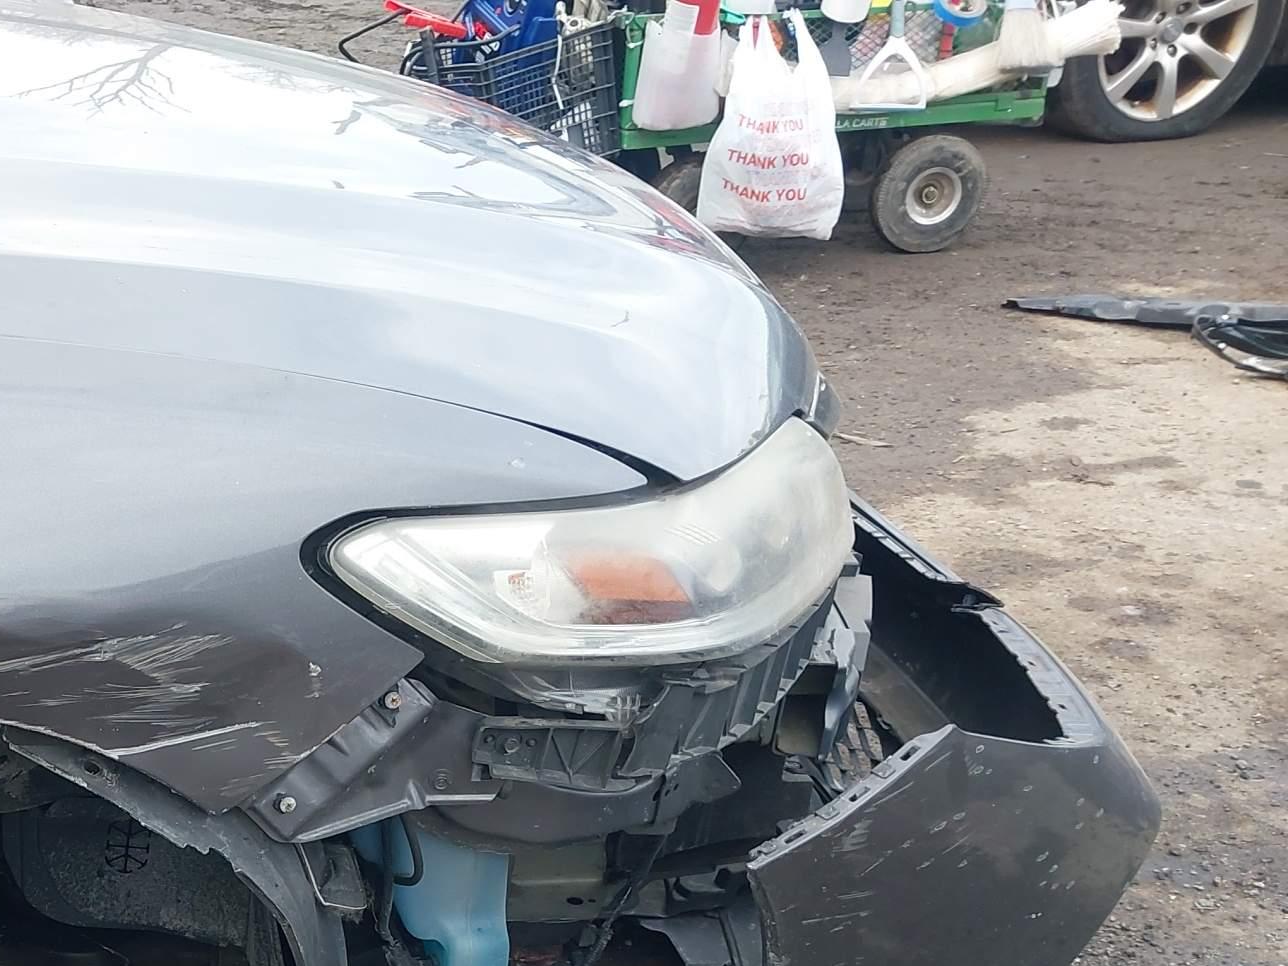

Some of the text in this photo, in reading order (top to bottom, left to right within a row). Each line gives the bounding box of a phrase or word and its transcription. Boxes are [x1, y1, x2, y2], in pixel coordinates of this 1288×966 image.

[781, 118, 804, 131] YOU
[728, 148, 809, 169] THANK YOU
[722, 178, 807, 202] THANK YOU
